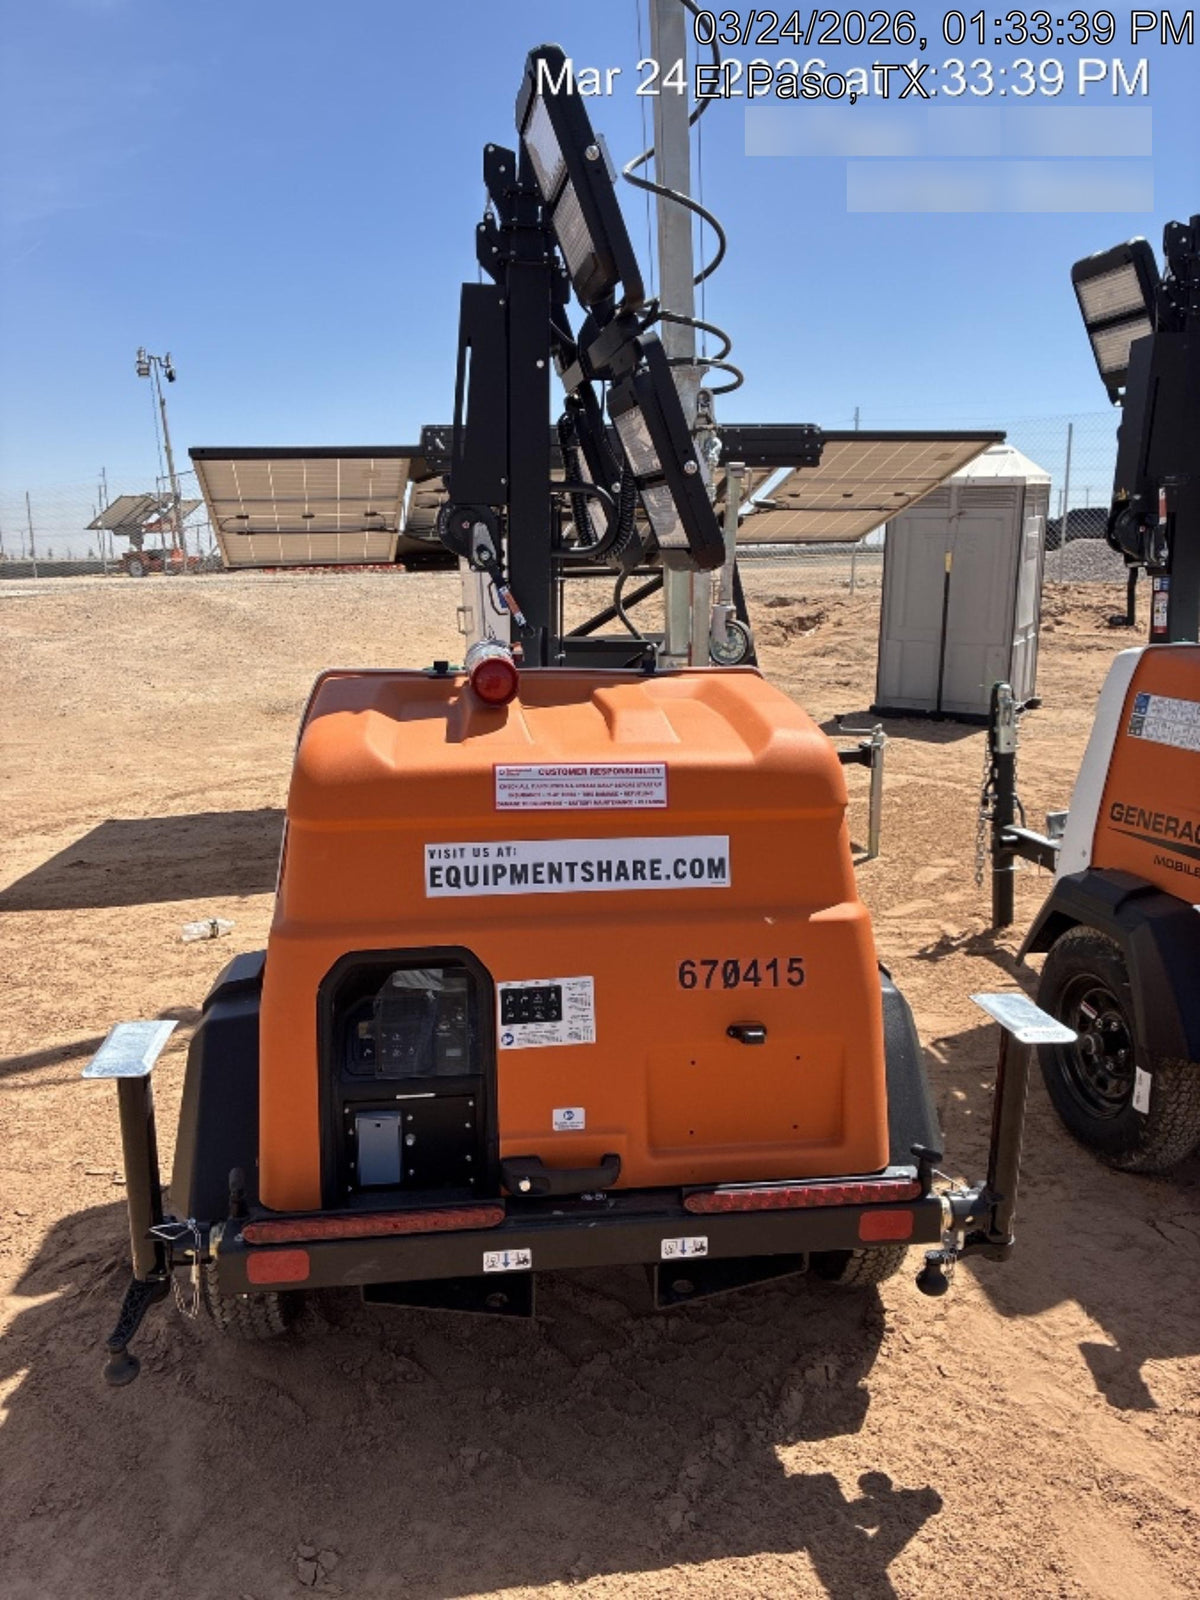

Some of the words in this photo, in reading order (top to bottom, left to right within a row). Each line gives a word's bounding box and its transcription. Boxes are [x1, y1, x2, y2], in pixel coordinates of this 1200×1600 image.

[538, 767, 588, 776] CUSTOMER
[428, 848, 466, 860] VISIT
[472, 847, 490, 858] US
[496, 846, 517, 858] AT:
[429, 857, 727, 889] EQUIPMENTSHARE.COM
[678, 957, 805, 989] 670415
